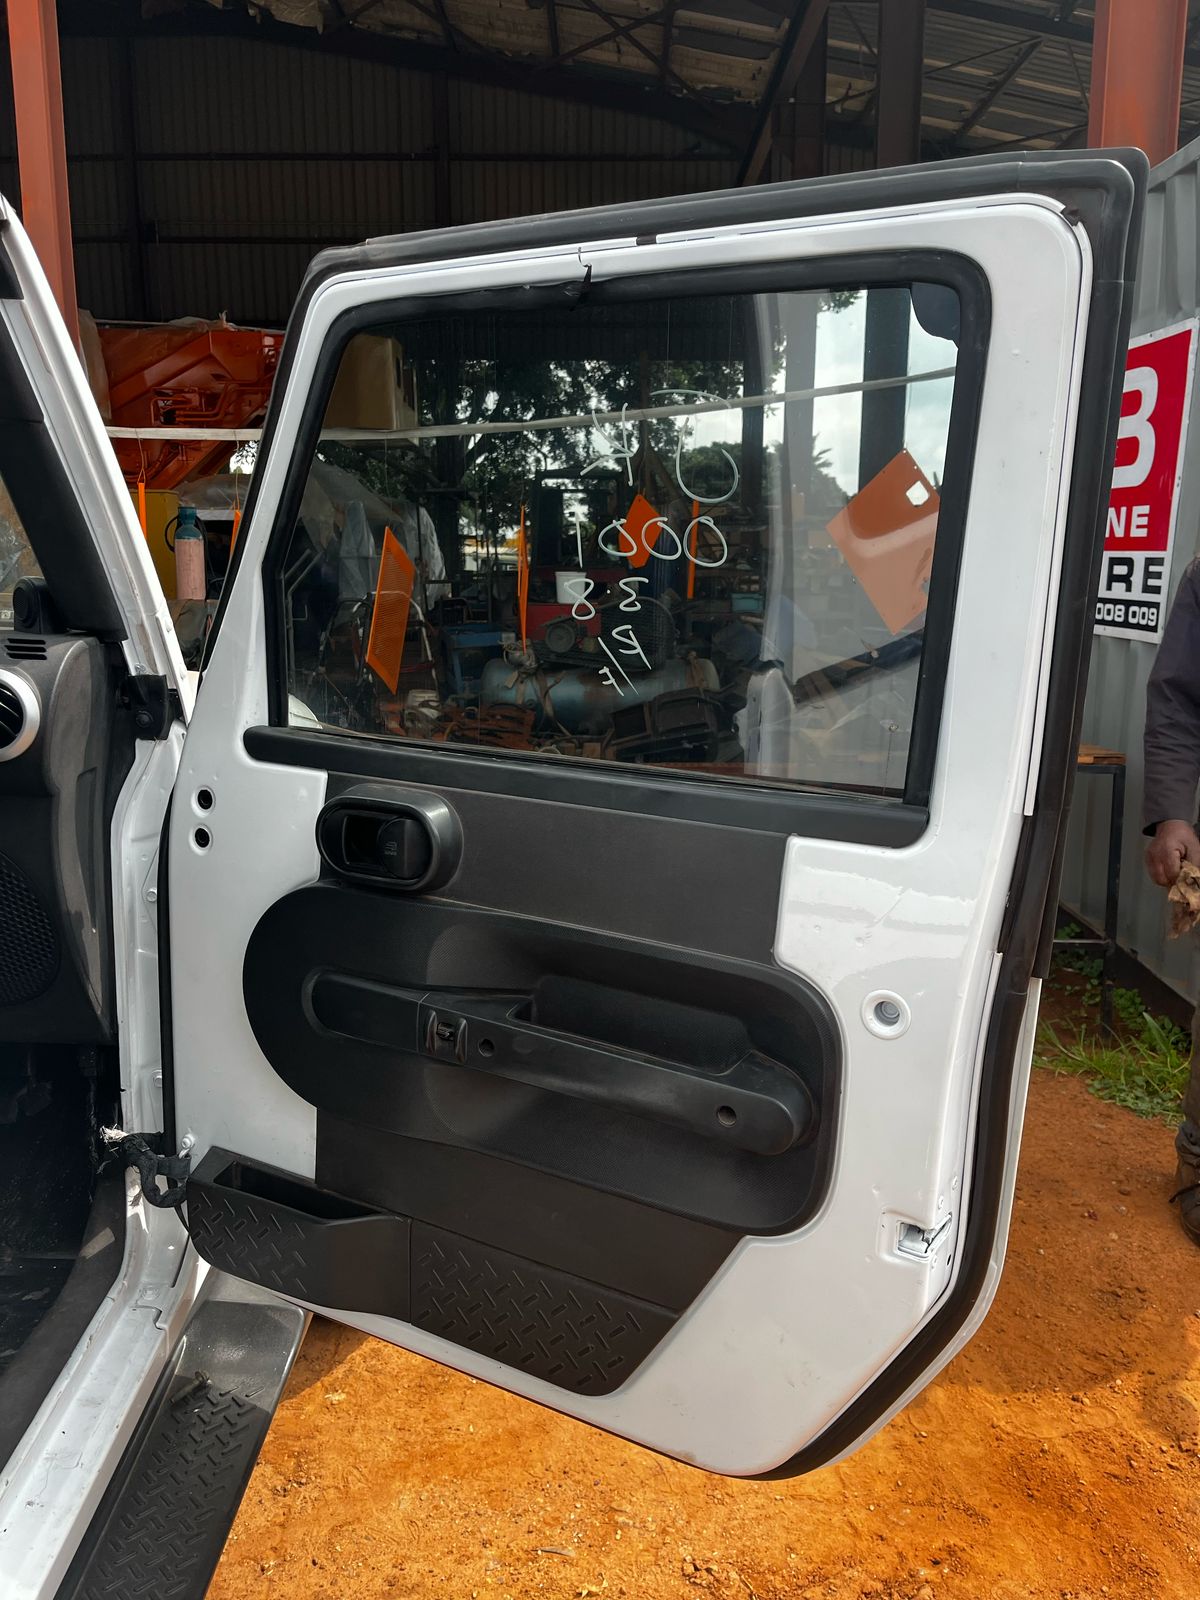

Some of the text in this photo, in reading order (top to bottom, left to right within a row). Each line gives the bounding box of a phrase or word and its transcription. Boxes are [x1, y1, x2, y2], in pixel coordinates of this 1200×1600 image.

[1105, 504, 1150, 538] NE
[1106, 556, 1165, 595] RE
[1095, 602, 1157, 627] 008 009
